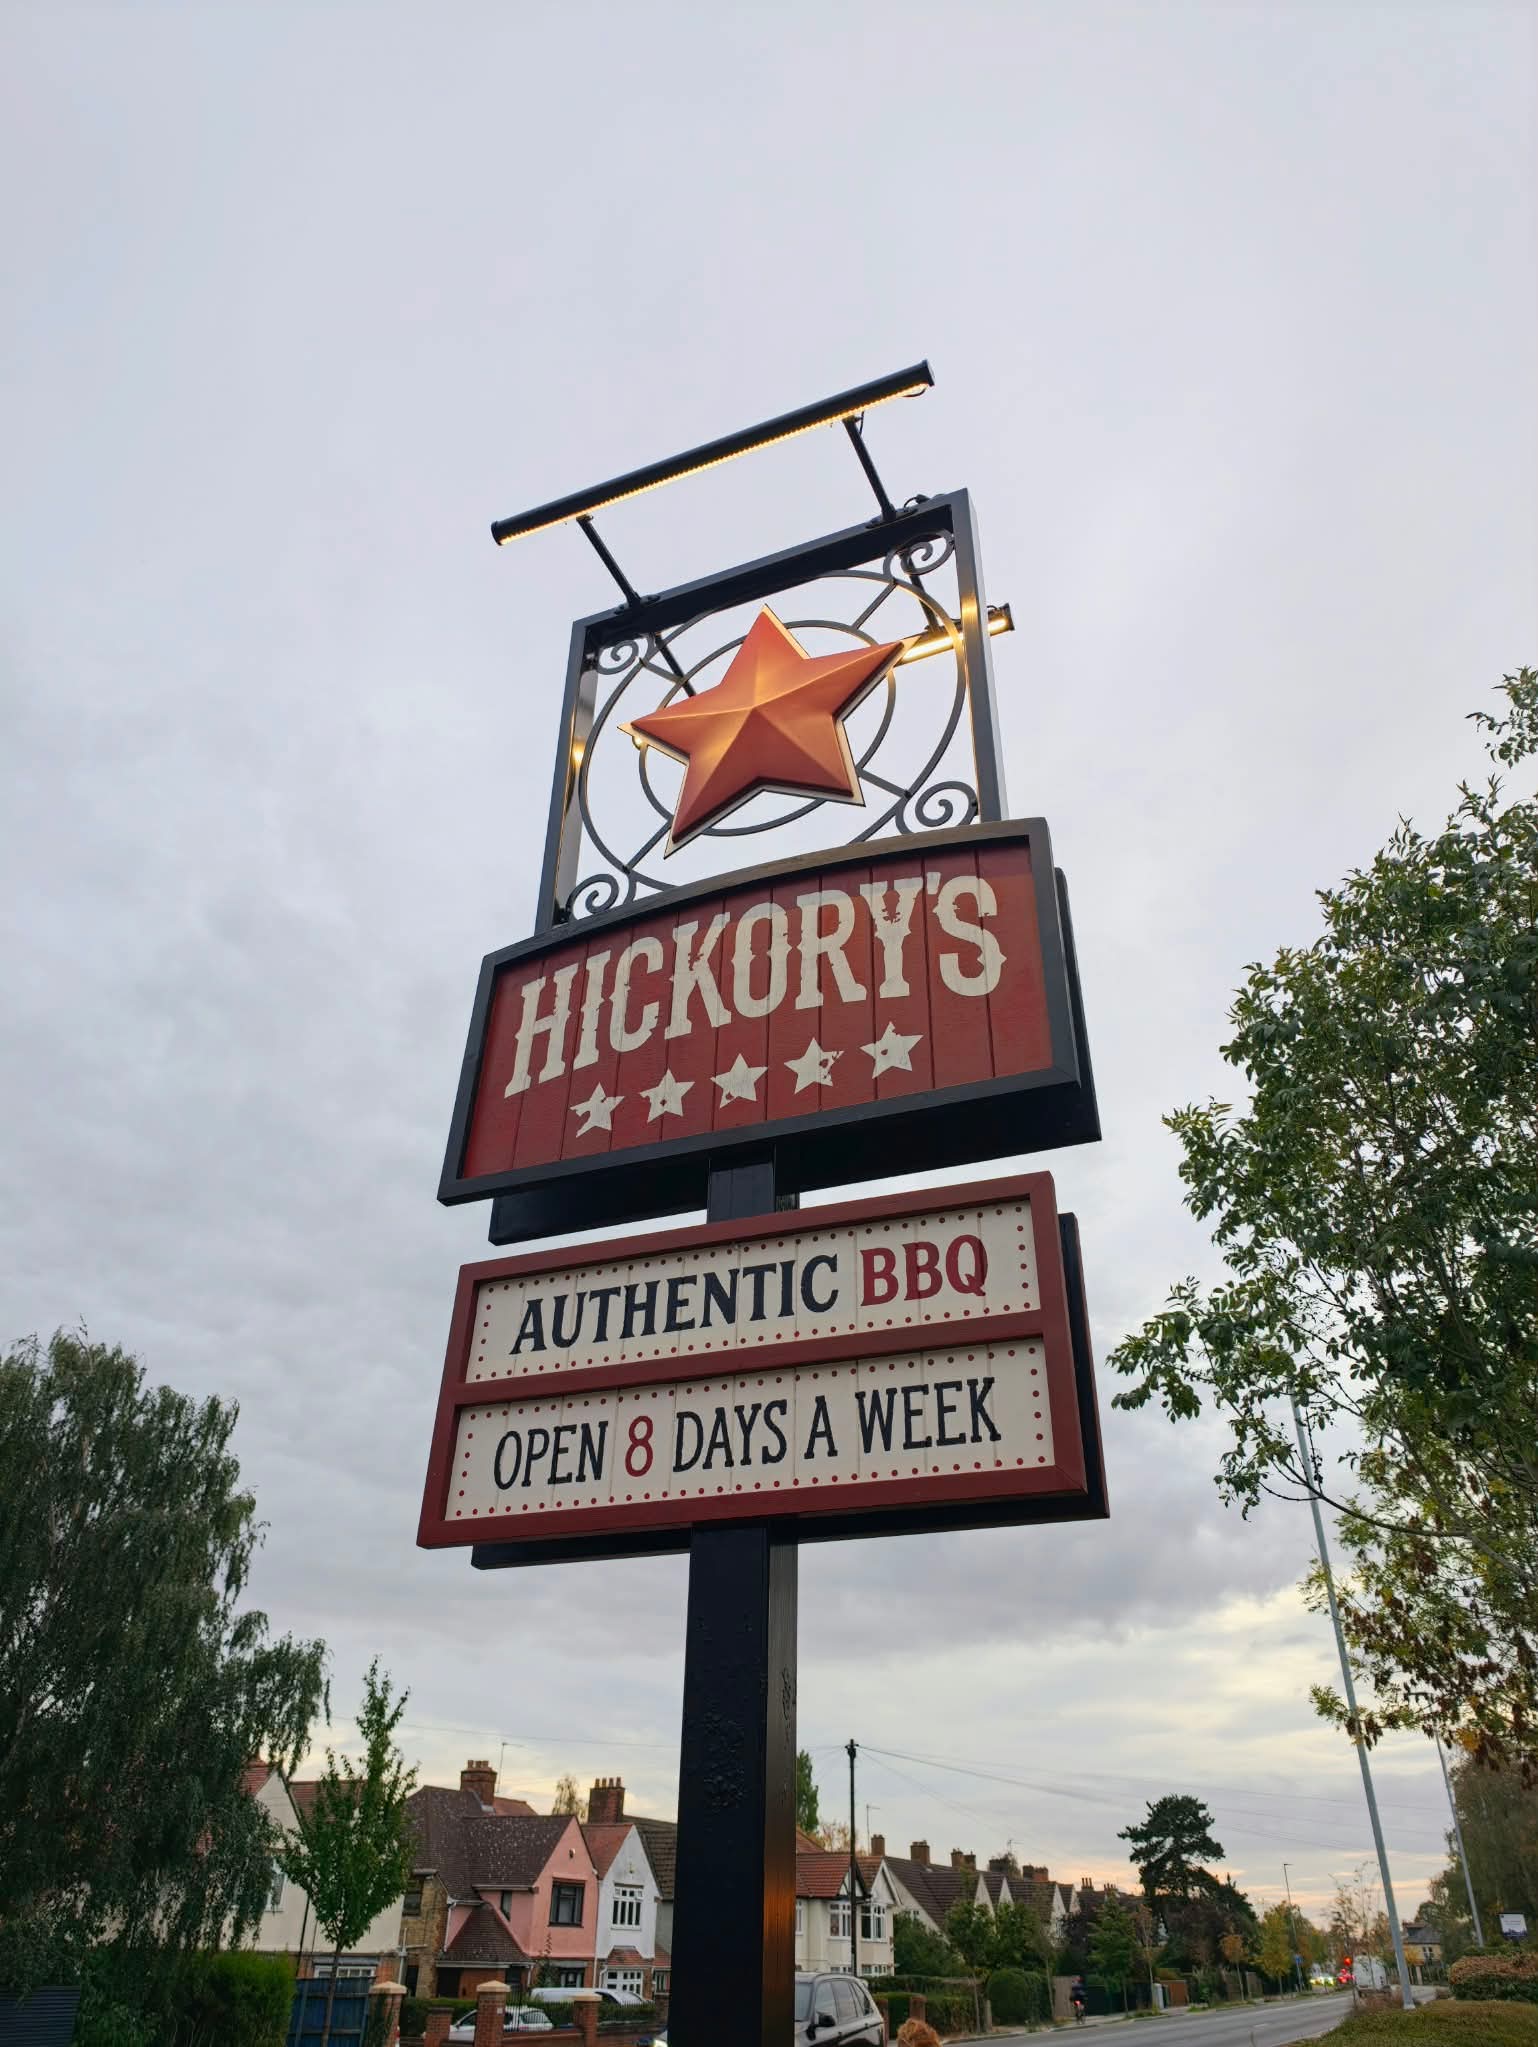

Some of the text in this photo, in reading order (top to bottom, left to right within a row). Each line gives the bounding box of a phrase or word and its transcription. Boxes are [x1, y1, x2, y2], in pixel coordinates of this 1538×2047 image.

[504, 871, 1007, 1098] HICKORY'S
[509, 1234, 989, 1356] AUTHENTIC BBQ
[493, 1376, 1002, 1491] OPEN 8 DAYS A WEEK
